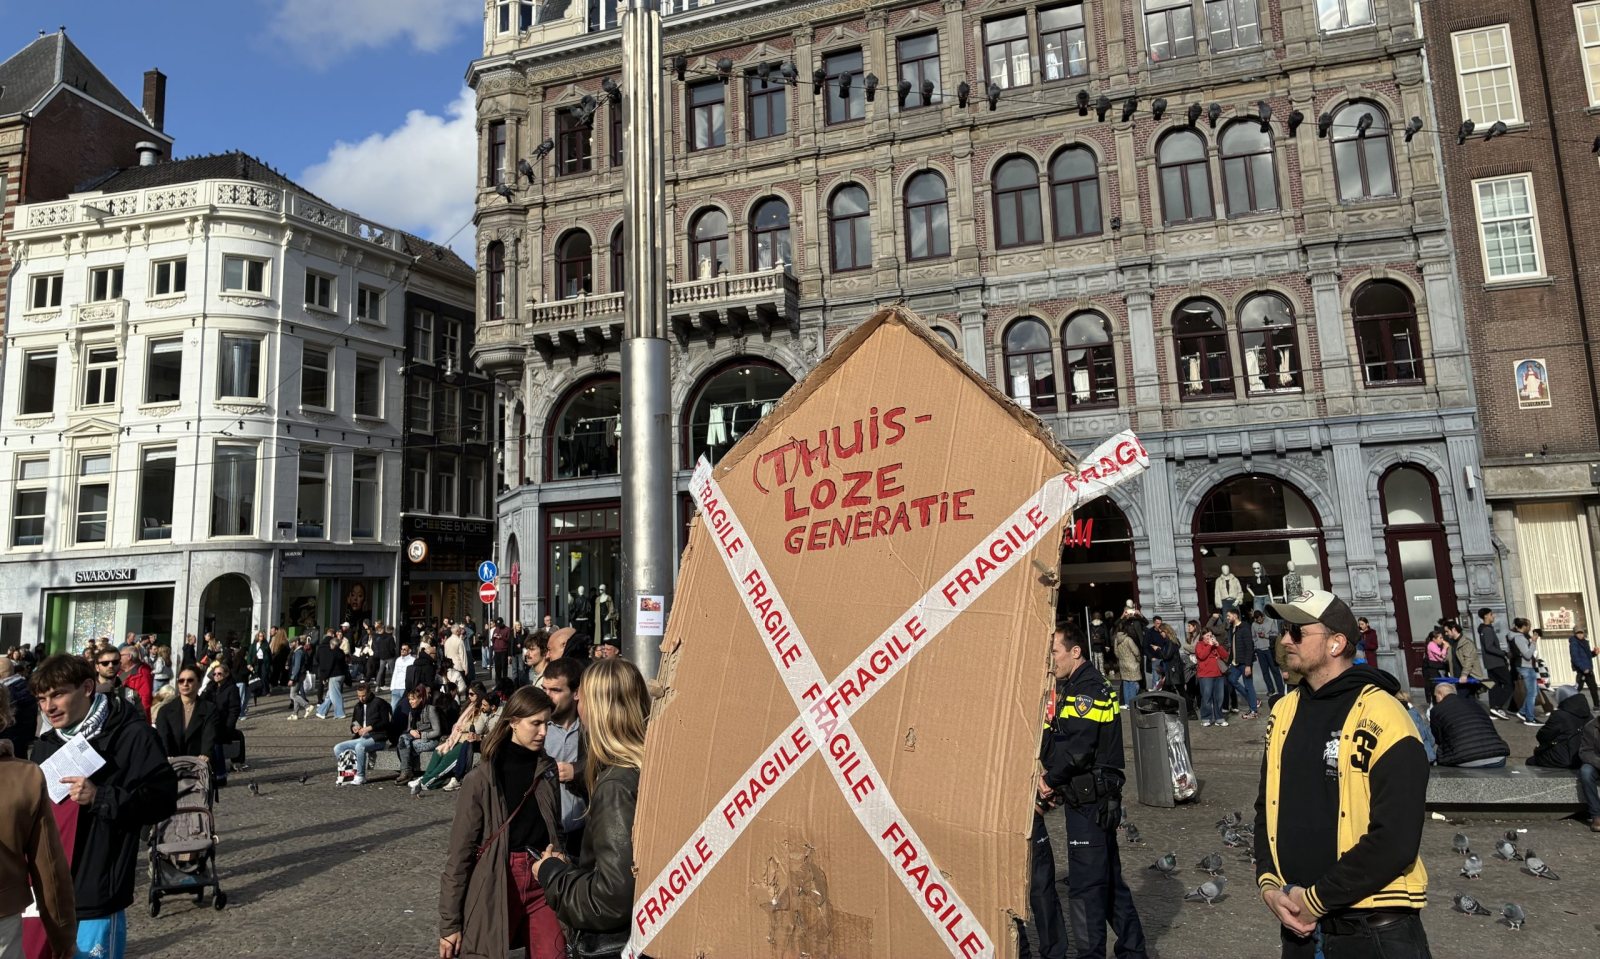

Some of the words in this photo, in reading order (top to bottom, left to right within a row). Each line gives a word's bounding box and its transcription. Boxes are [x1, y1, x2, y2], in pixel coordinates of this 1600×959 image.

[784, 462, 904, 521] LOZE
[76, 568, 131, 582] SWAROVSKI
[941, 504, 1049, 607] FRAGILE
[743, 568, 802, 669] FRAGILE
[825, 616, 927, 718] FRAGILE
[723, 726, 812, 829] FRAGILE
[801, 682, 875, 803] FRAGILE
[635, 836, 713, 936] FRAGILE
[882, 821, 985, 959] FRAGILE
